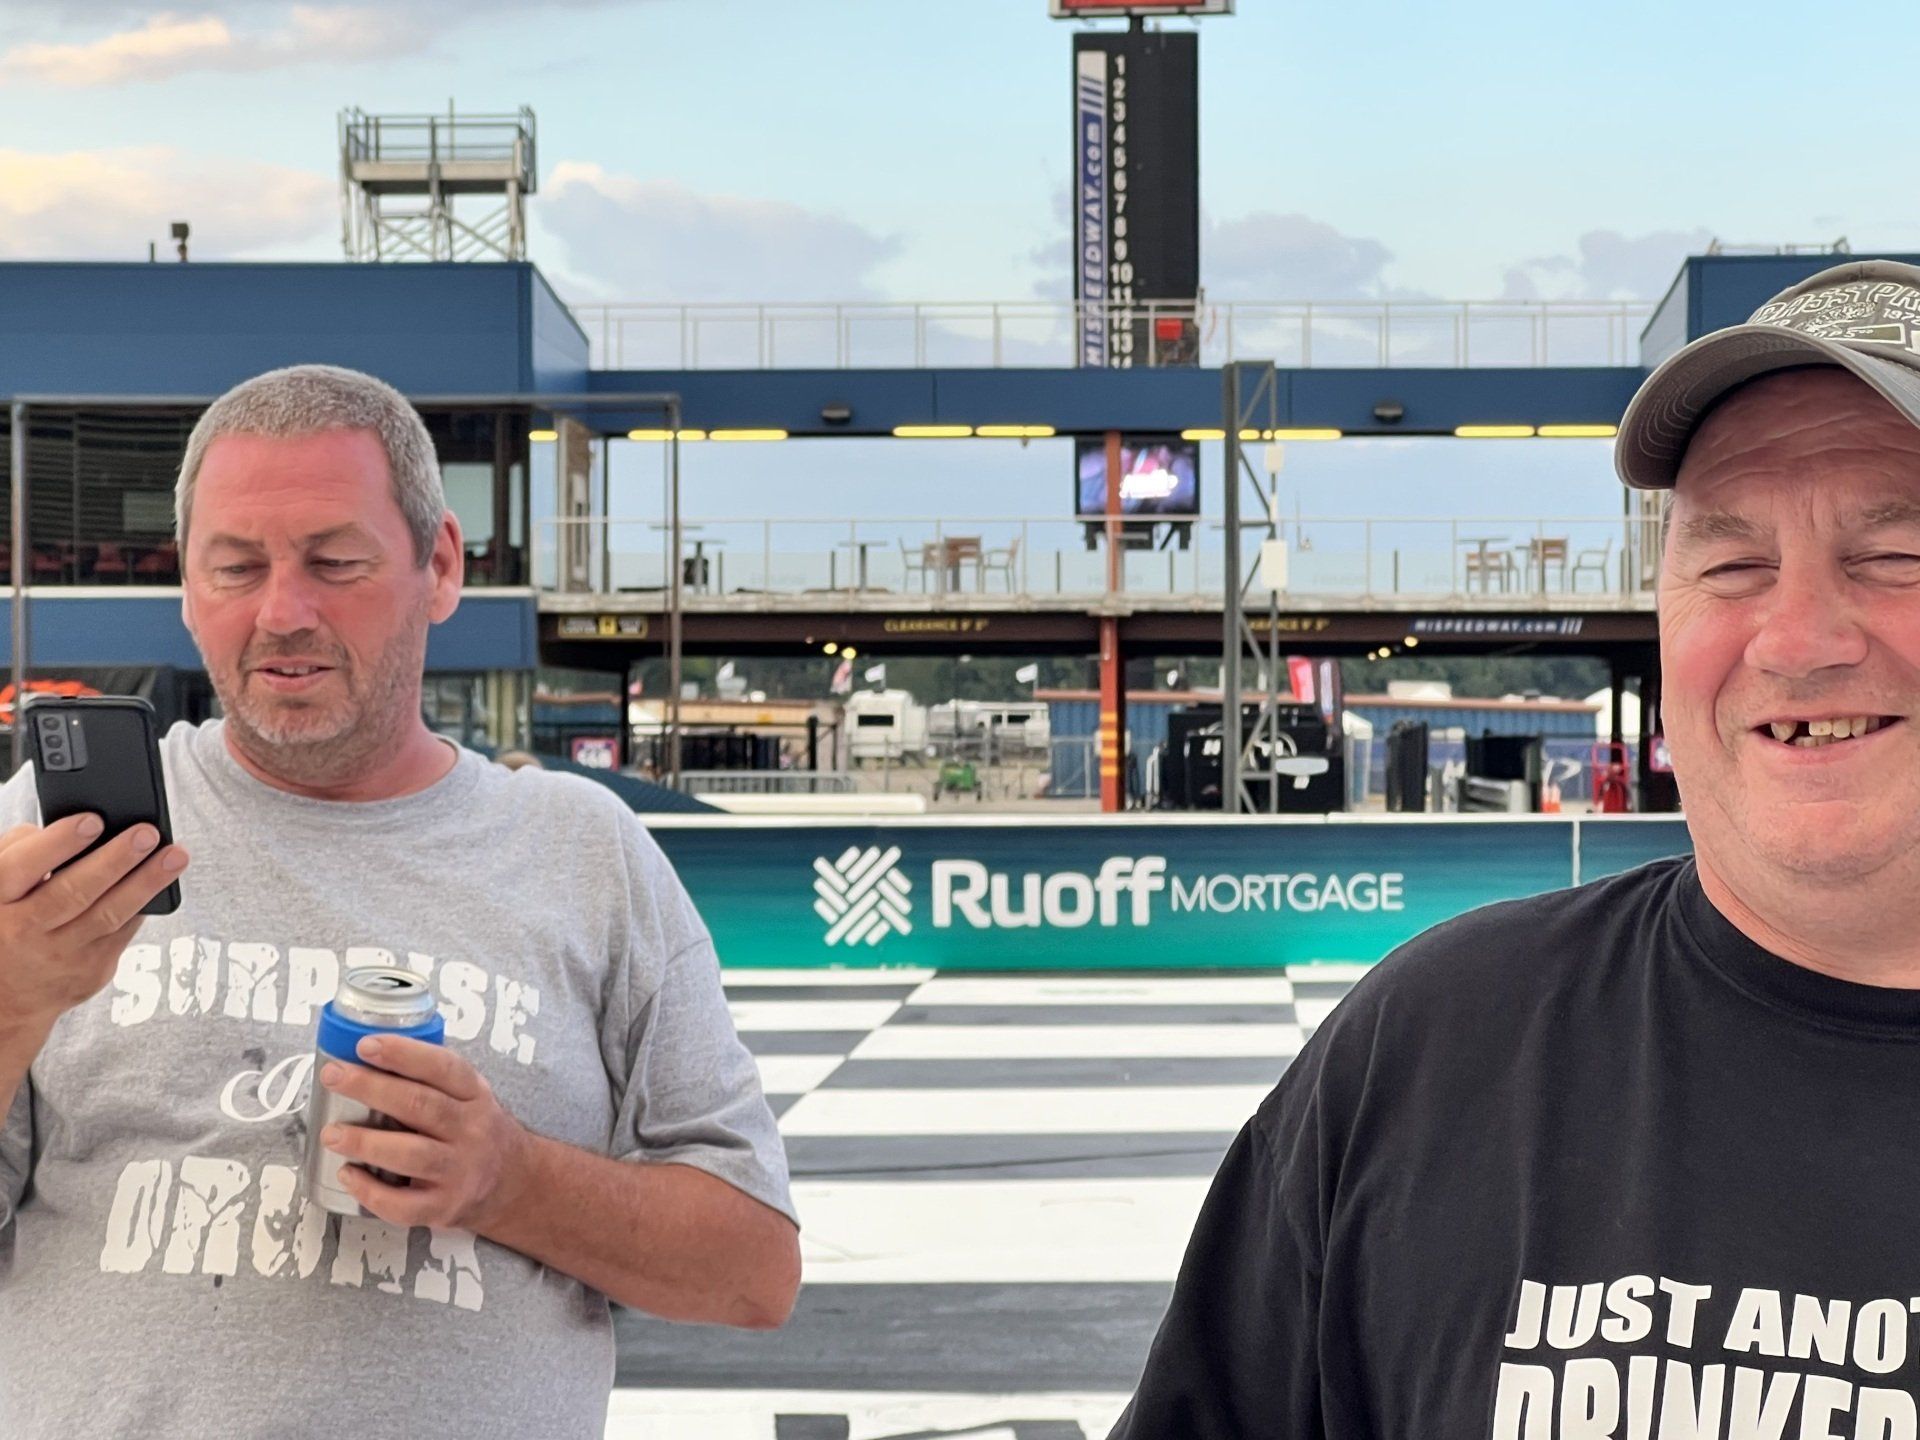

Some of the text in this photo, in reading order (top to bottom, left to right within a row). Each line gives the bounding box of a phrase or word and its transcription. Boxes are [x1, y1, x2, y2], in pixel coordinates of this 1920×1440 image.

[1114, 54, 1126, 75] 1
[1113, 78, 1126, 99] 2
[1113, 101, 1126, 122] 3
[1113, 124, 1126, 145] 4
[1113, 146, 1127, 168] 5
[1114, 170, 1127, 192] 6
[1113, 193, 1127, 214] 7
[1113, 216, 1127, 238] 8
[1114, 239, 1127, 261] 9
[1110, 262, 1134, 284] 10
[1111, 286, 1133, 306] 11
[1868, 283, 1920, 311] PR
[1111, 308, 1133, 330] 12
[1111, 332, 1133, 354] 13
[932, 856, 1405, 928] Ruoff MORTGAGE
[111, 935, 540, 1065] SURPSE
[1505, 1275, 1920, 1374] JUST ANO
